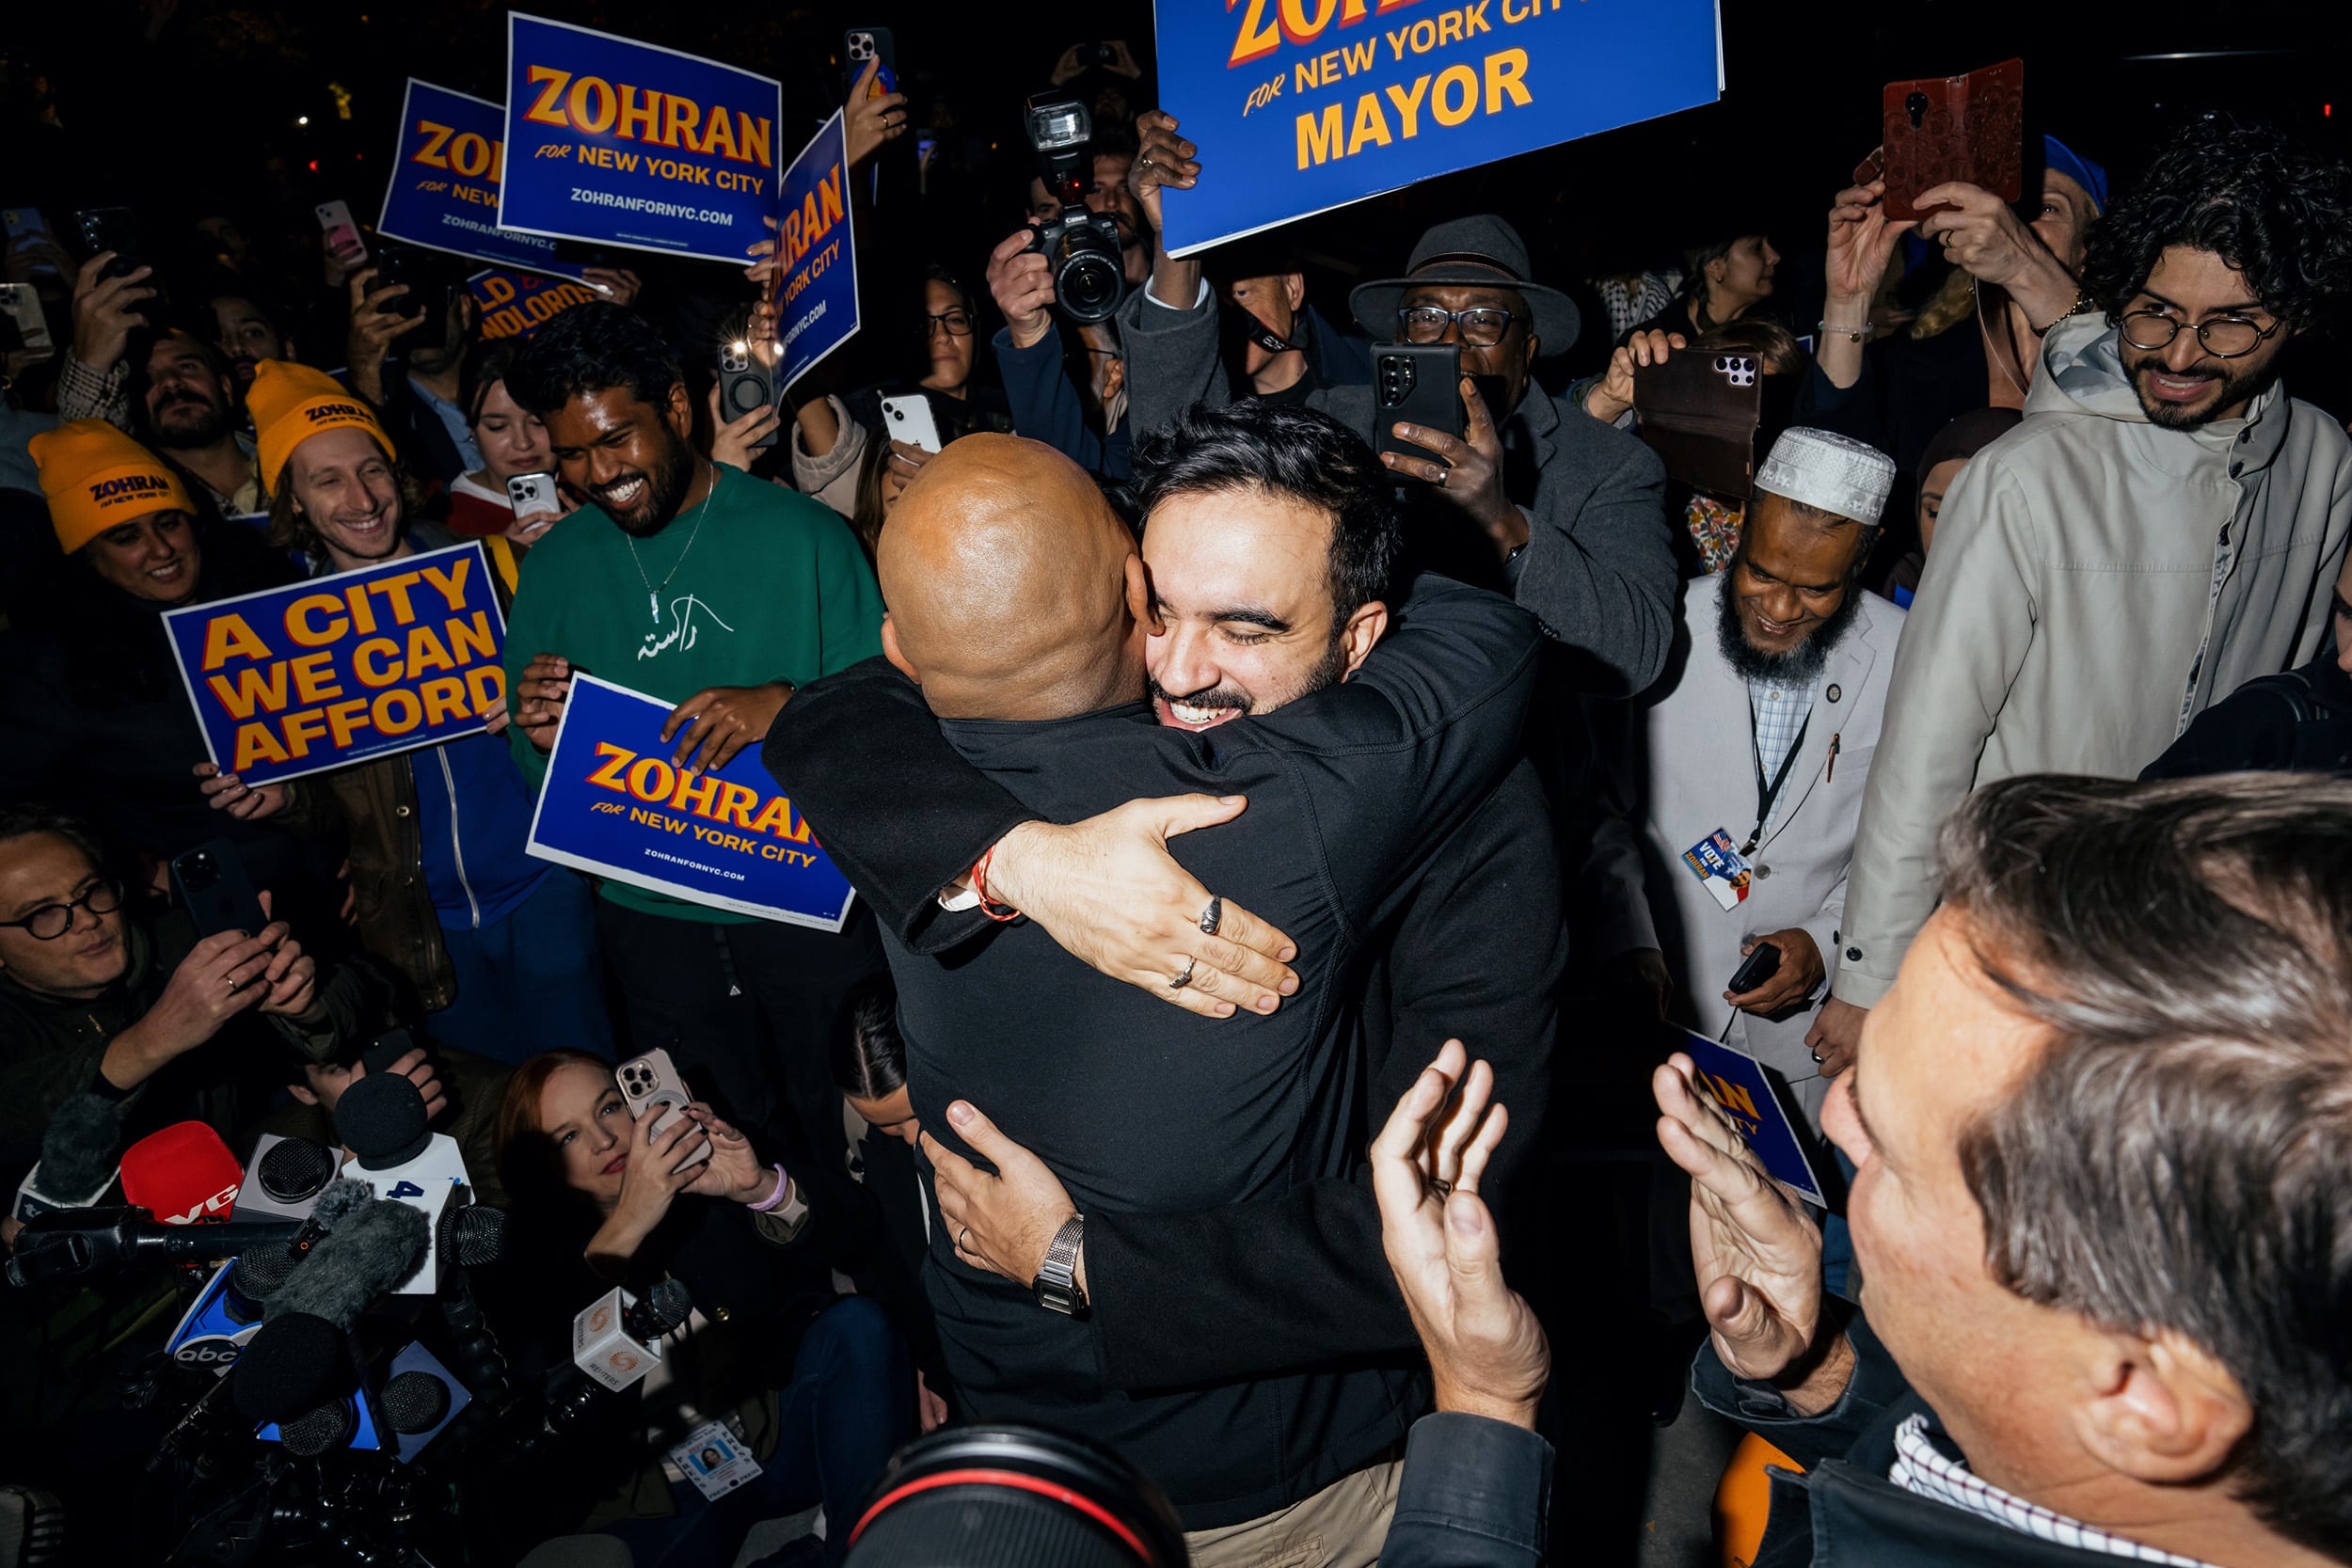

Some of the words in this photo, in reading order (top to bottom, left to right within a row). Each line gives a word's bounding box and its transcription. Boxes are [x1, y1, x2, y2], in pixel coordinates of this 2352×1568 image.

[1243, 73, 1285, 117] FOR
[1295, 37, 1376, 94] NEW
[1385, 0, 1491, 60] YORK
[522, 64, 772, 168] ZOHRAN
[1296, 47, 1534, 170] MAYOR
[416, 180, 448, 192] FOR
[453, 183, 499, 208] NEW
[534, 144, 571, 158] FOR
[577, 144, 639, 172] NEW
[644, 156, 710, 186] YORK
[715, 170, 764, 195] CITY
[570, 187, 733, 226] ZOHRANFORNYC.COM
[784, 264, 811, 309] YORK
[811, 237, 840, 279] CITY
[89, 474, 169, 501] ZOHRAN
[201, 613, 273, 672] A
[284, 558, 471, 648] CITY
[206, 650, 343, 721] WE
[353, 610, 498, 688] CAN
[233, 664, 506, 773] AFFORD
[590, 800, 626, 816] FOR
[629, 807, 688, 835] NEW
[692, 824, 758, 855] YORK
[760, 843, 818, 869] CITY
[1699, 841, 1725, 870] VOTE
[644, 847, 745, 881] ZOHRANFORNYC.COM
[164, 1183, 239, 1225] VG
[386, 1180, 425, 1199] 4
[176, 1346, 238, 1363] abc
